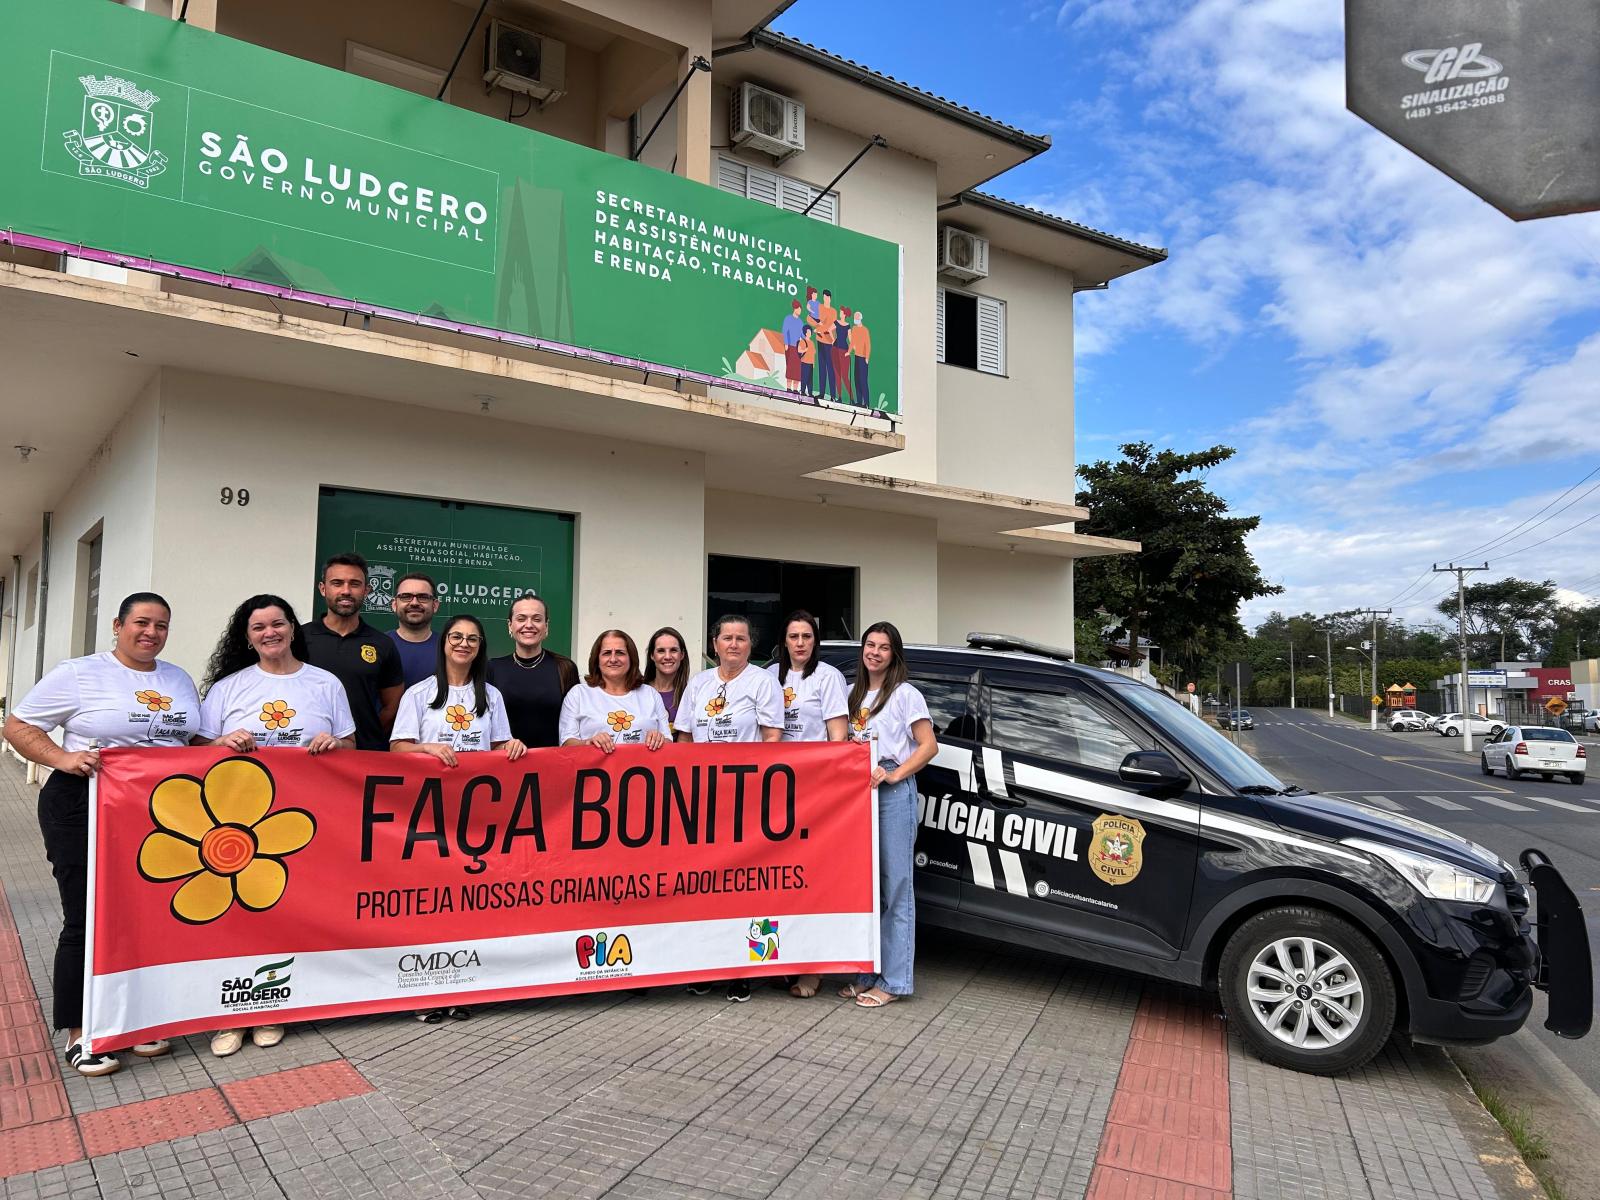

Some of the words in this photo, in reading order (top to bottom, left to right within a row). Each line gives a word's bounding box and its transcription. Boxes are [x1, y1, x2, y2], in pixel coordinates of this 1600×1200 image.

[1400, 76, 1510, 110] SINALIZAÇÃO
[1405, 107, 1431, 120] (48)
[1434, 93, 1505, 115] 3642-2088
[85, 166, 102, 174] SÃO
[105, 169, 145, 186] LUDGERO
[200, 131, 288, 174] SÃO
[304, 157, 487, 225] LUDGERO
[198, 160, 335, 205] GOVERNO
[346, 196, 484, 242] MUNICIPAL
[595, 189, 708, 235] SECRETARIA
[712, 224, 802, 262] MUNICIPAL
[595, 209, 619, 229] DE
[625, 218, 741, 263] ASSISTÊNCIA
[745, 253, 809, 284] SOCIAL,
[594, 229, 707, 274] HABITAÇÃO,
[711, 261, 798, 296] TRABALHO
[594, 249, 604, 265] E
[610, 253, 672, 282] RENDA
[220, 486, 250, 507] 99
[376, 544, 435, 554] ASSISTÊNCIA
[393, 537, 447, 548] SECRETARIA
[449, 541, 496, 552] MUNICIPAL
[409, 554, 456, 564] TRABALHO
[465, 559, 493, 567] RENDA
[438, 595, 469, 604] ERNO
[360, 772, 547, 875] FAÇA
[571, 763, 809, 852] BONITO.
[917, 792, 995, 843] LÍCIA
[1001, 813, 1079, 862] CIVIL
[1100, 864, 1127, 876] CIVIL
[356, 886, 454, 920] PROTEJA
[460, 879, 545, 912] NOSSAS
[550, 873, 651, 905] CRIANÇAS
[656, 872, 667, 897] E
[673, 865, 809, 896] ADOLECENTES.
[398, 949, 482, 973] CMDCA
[221, 976, 253, 992] SÃO
[221, 986, 291, 1005] LUDGERO
